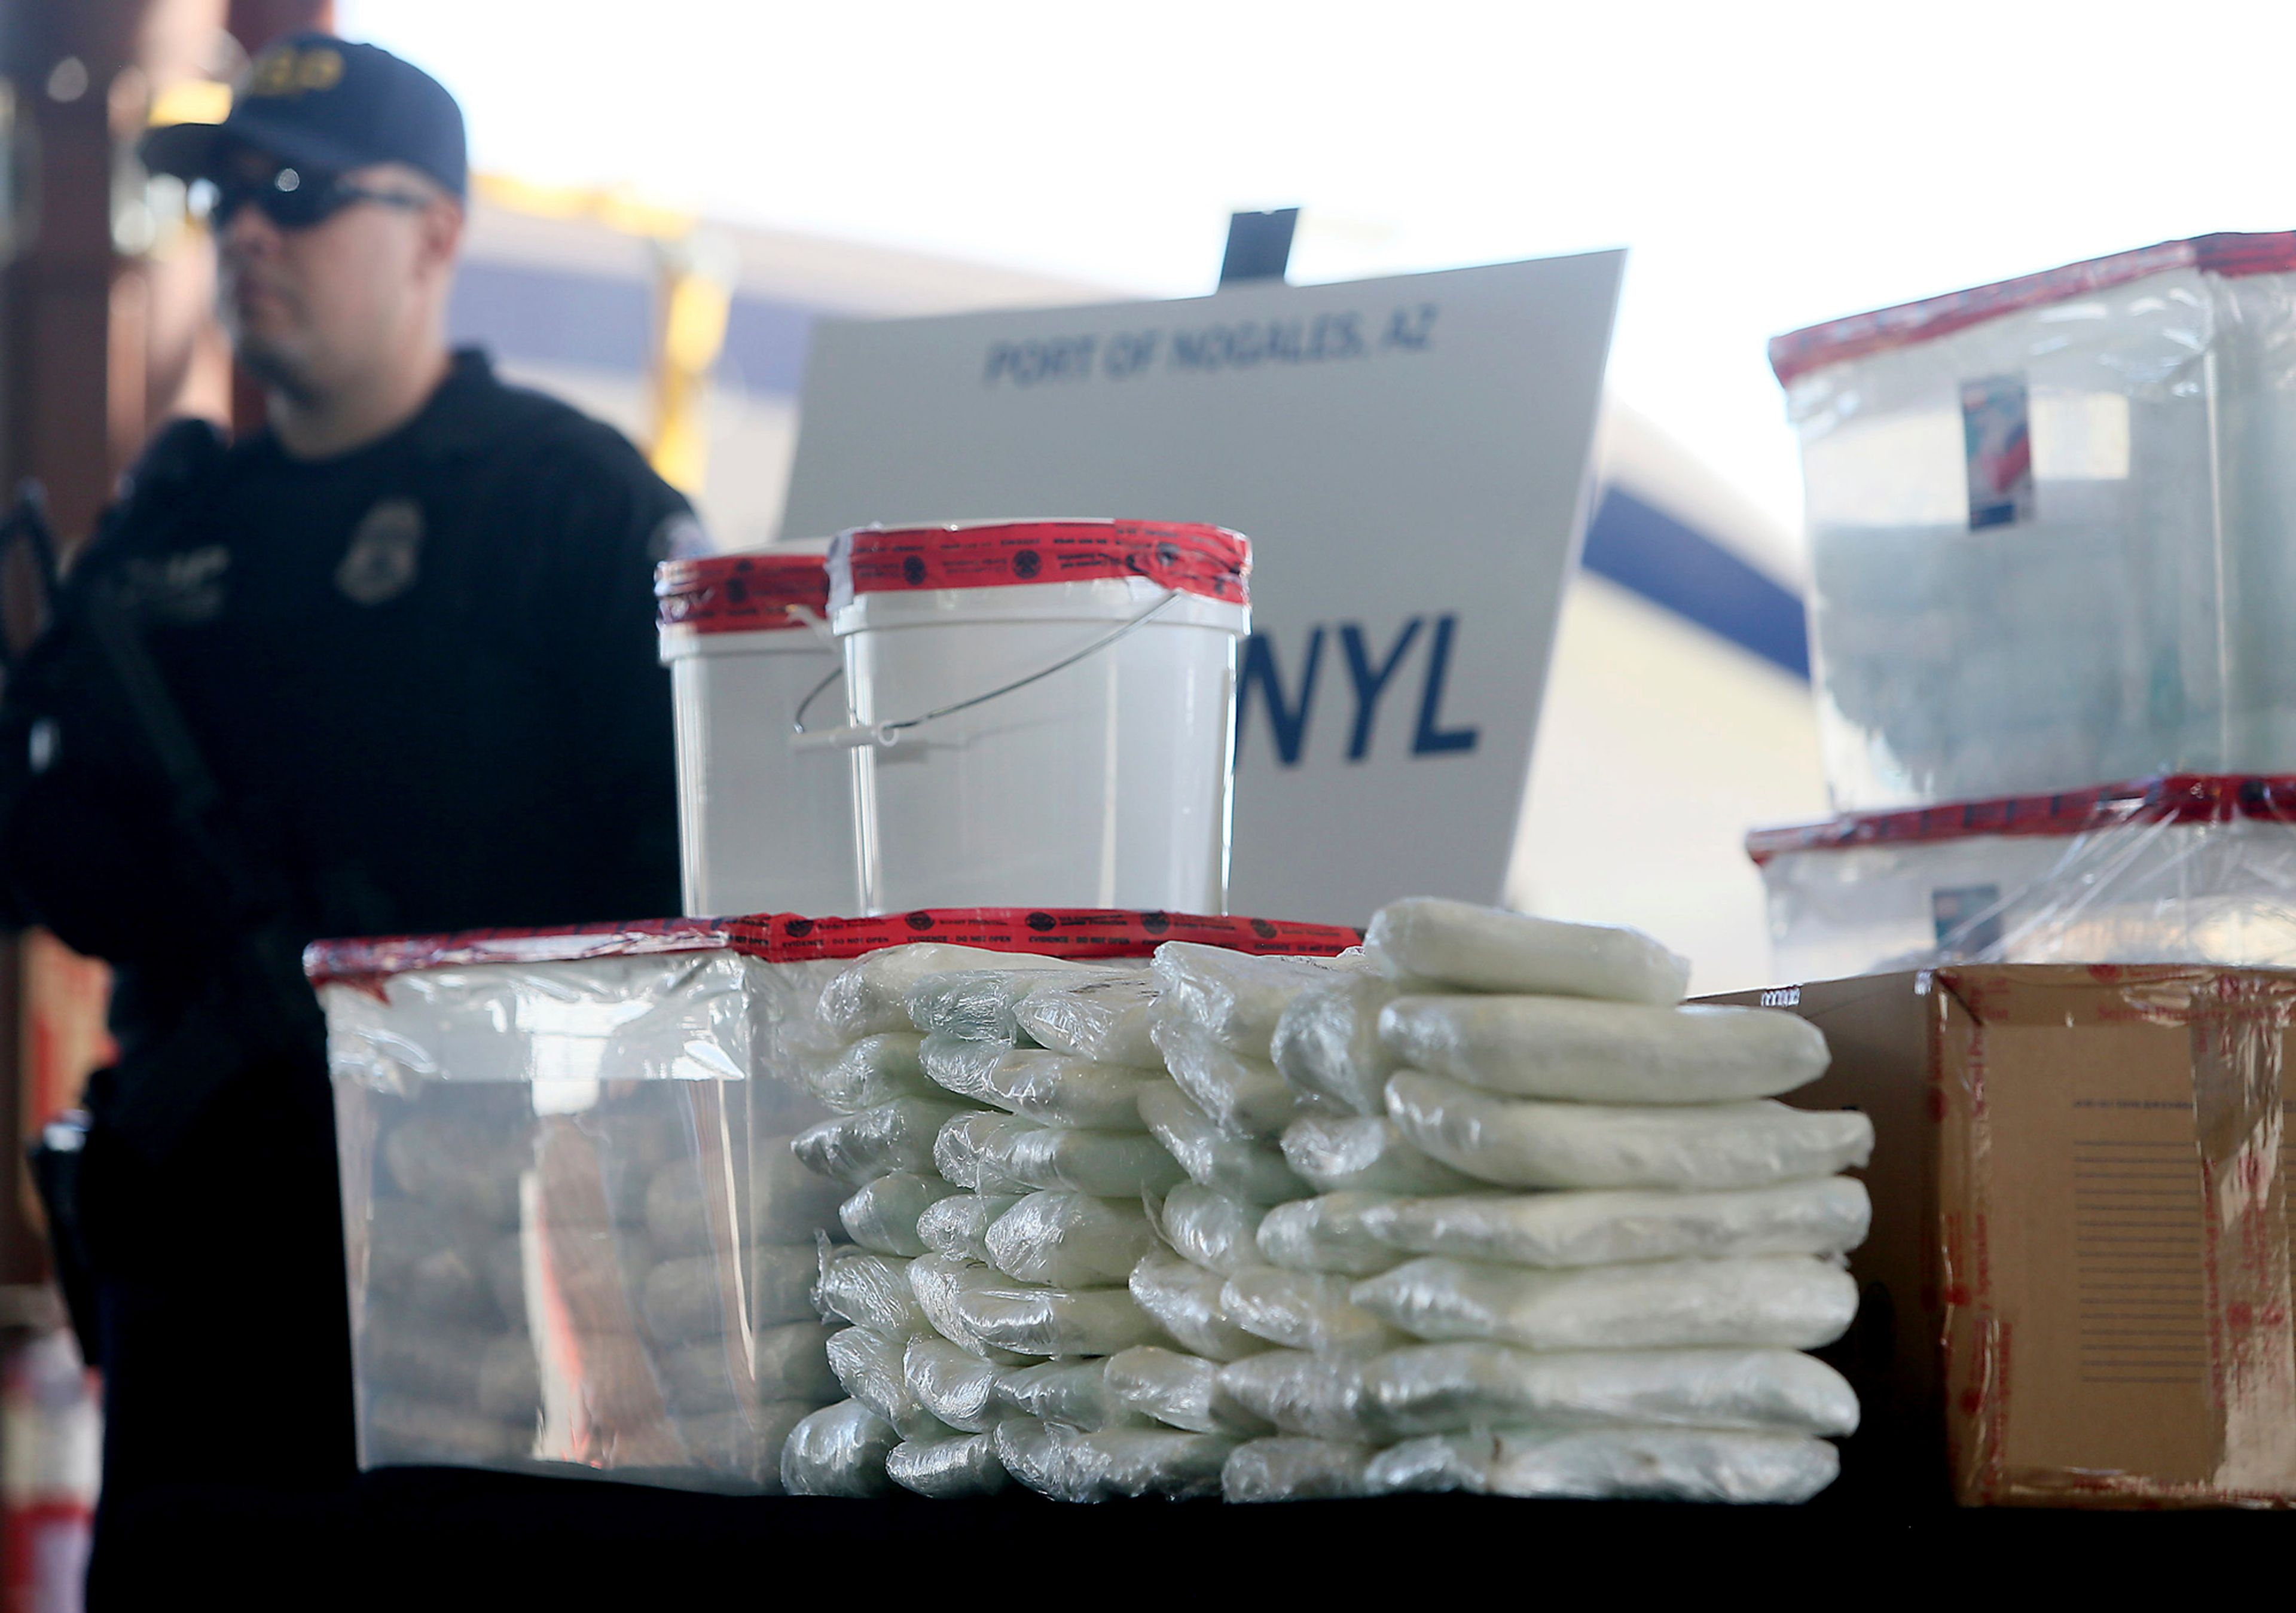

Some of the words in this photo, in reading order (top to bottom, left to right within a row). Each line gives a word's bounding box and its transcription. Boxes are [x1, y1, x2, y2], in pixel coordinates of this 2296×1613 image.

[984, 336, 1094, 389] PORT
[1103, 328, 1158, 379] OF
[1381, 303, 1437, 350] AZ
